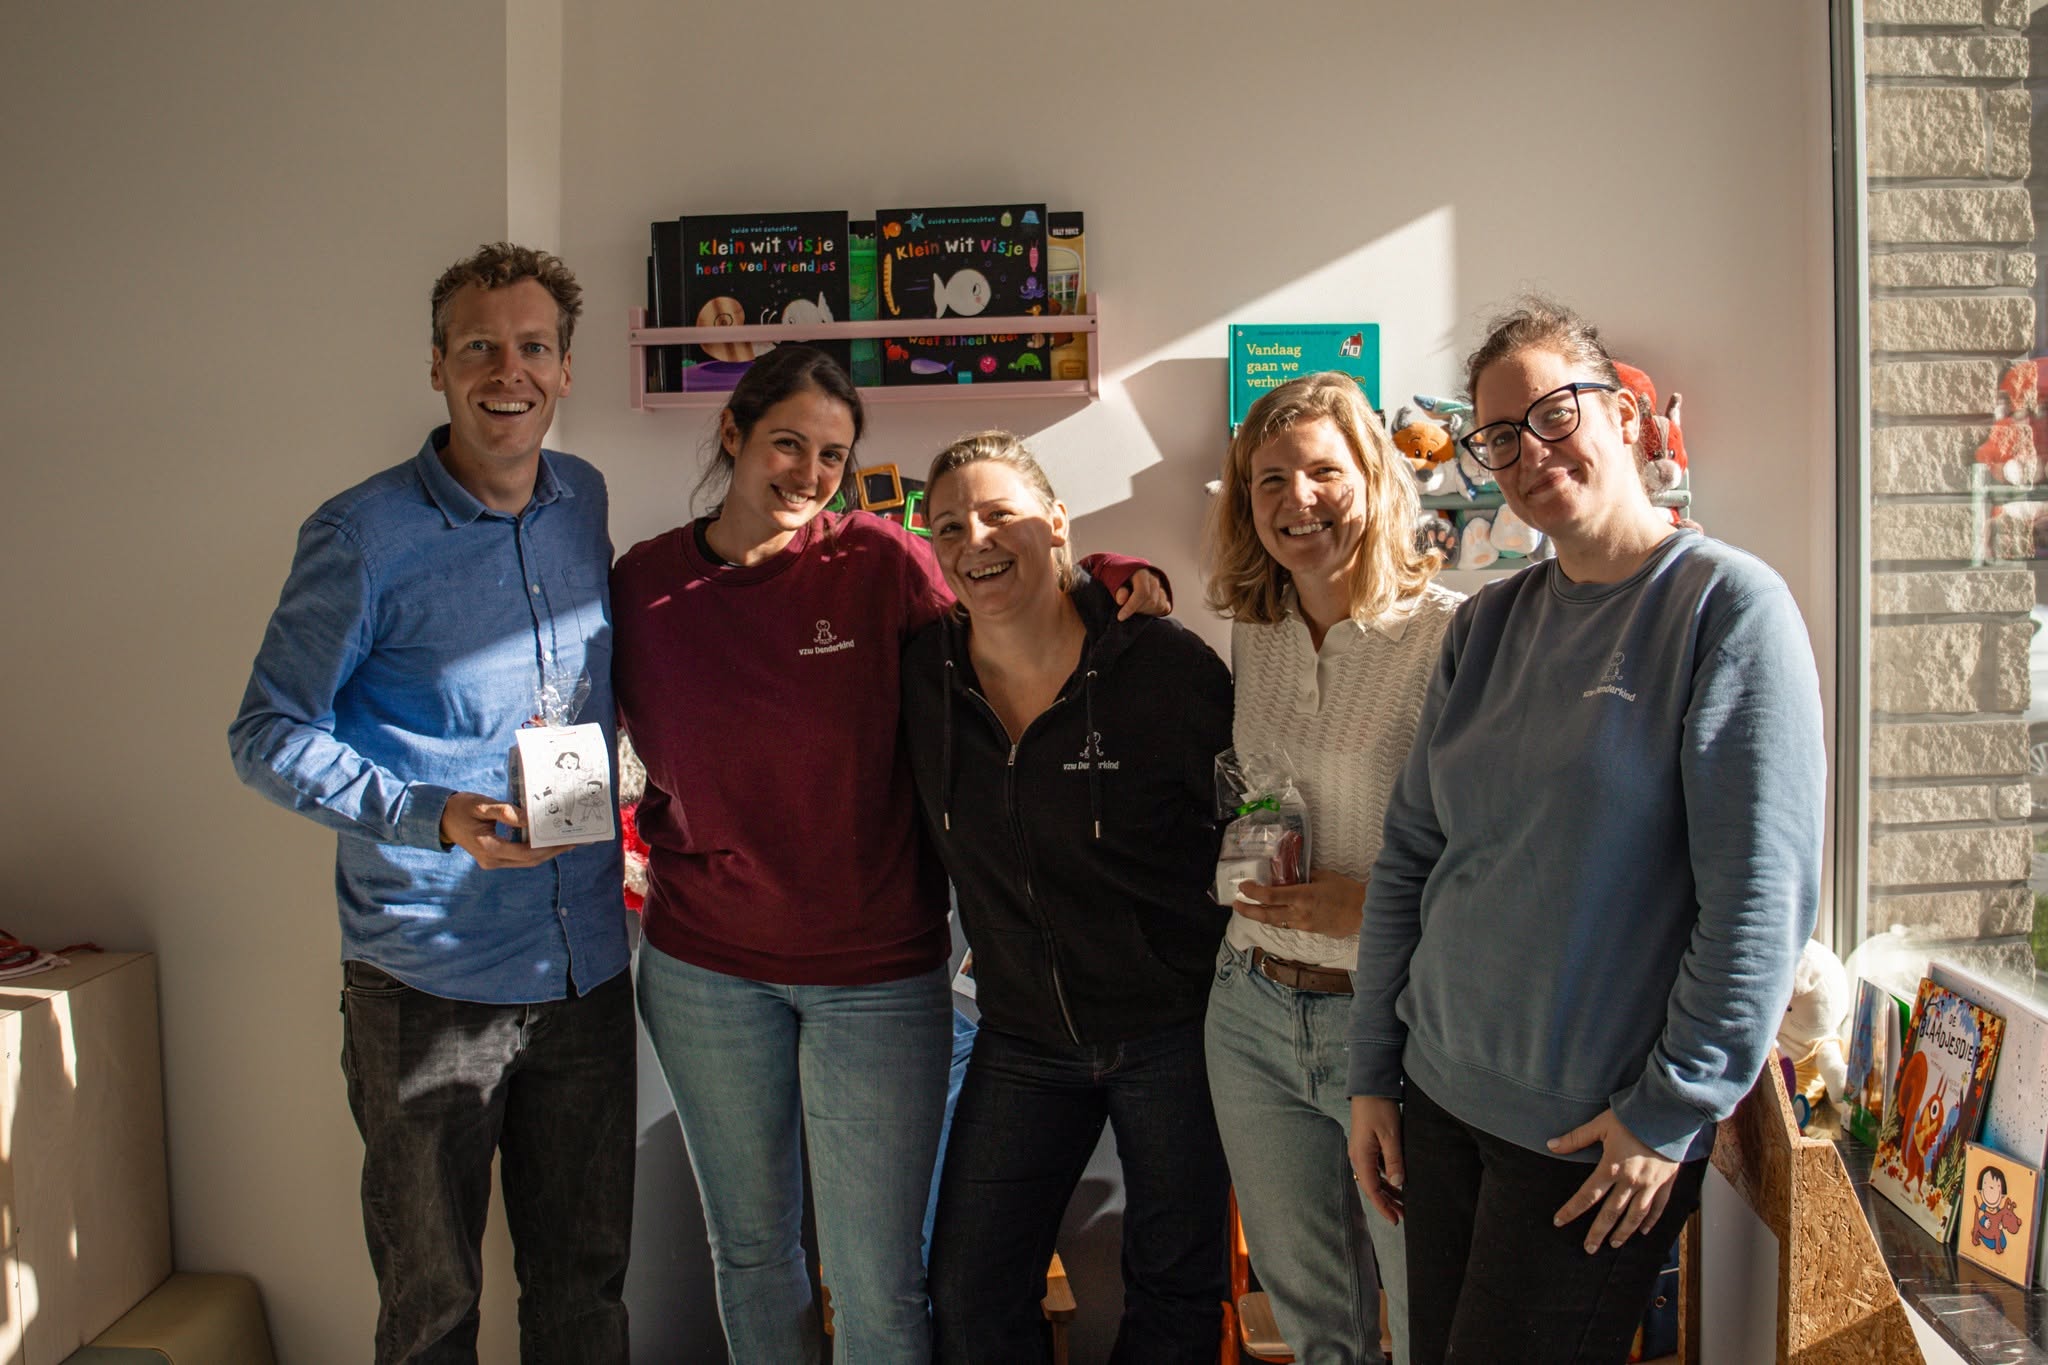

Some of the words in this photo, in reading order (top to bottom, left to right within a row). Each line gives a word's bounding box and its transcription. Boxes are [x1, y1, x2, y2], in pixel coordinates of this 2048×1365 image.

[699, 237, 745, 255] Klein
[751, 236, 781, 254] wit
[787, 235, 834, 255] visje
[896, 241, 939, 260] Klein
[945, 237, 974, 253] wit
[980, 238, 1024, 257] visje
[696, 261, 733, 275] heeft
[739, 259, 768, 272] veel
[773, 259, 836, 274] vriendjes
[1246, 343, 1301, 357] Vandaag
[1247, 362, 1278, 374] gaan
[1281, 362, 1299, 371] we
[815, 640, 854, 654] Denderkind
[1949, 1014, 1957, 1027] DE
